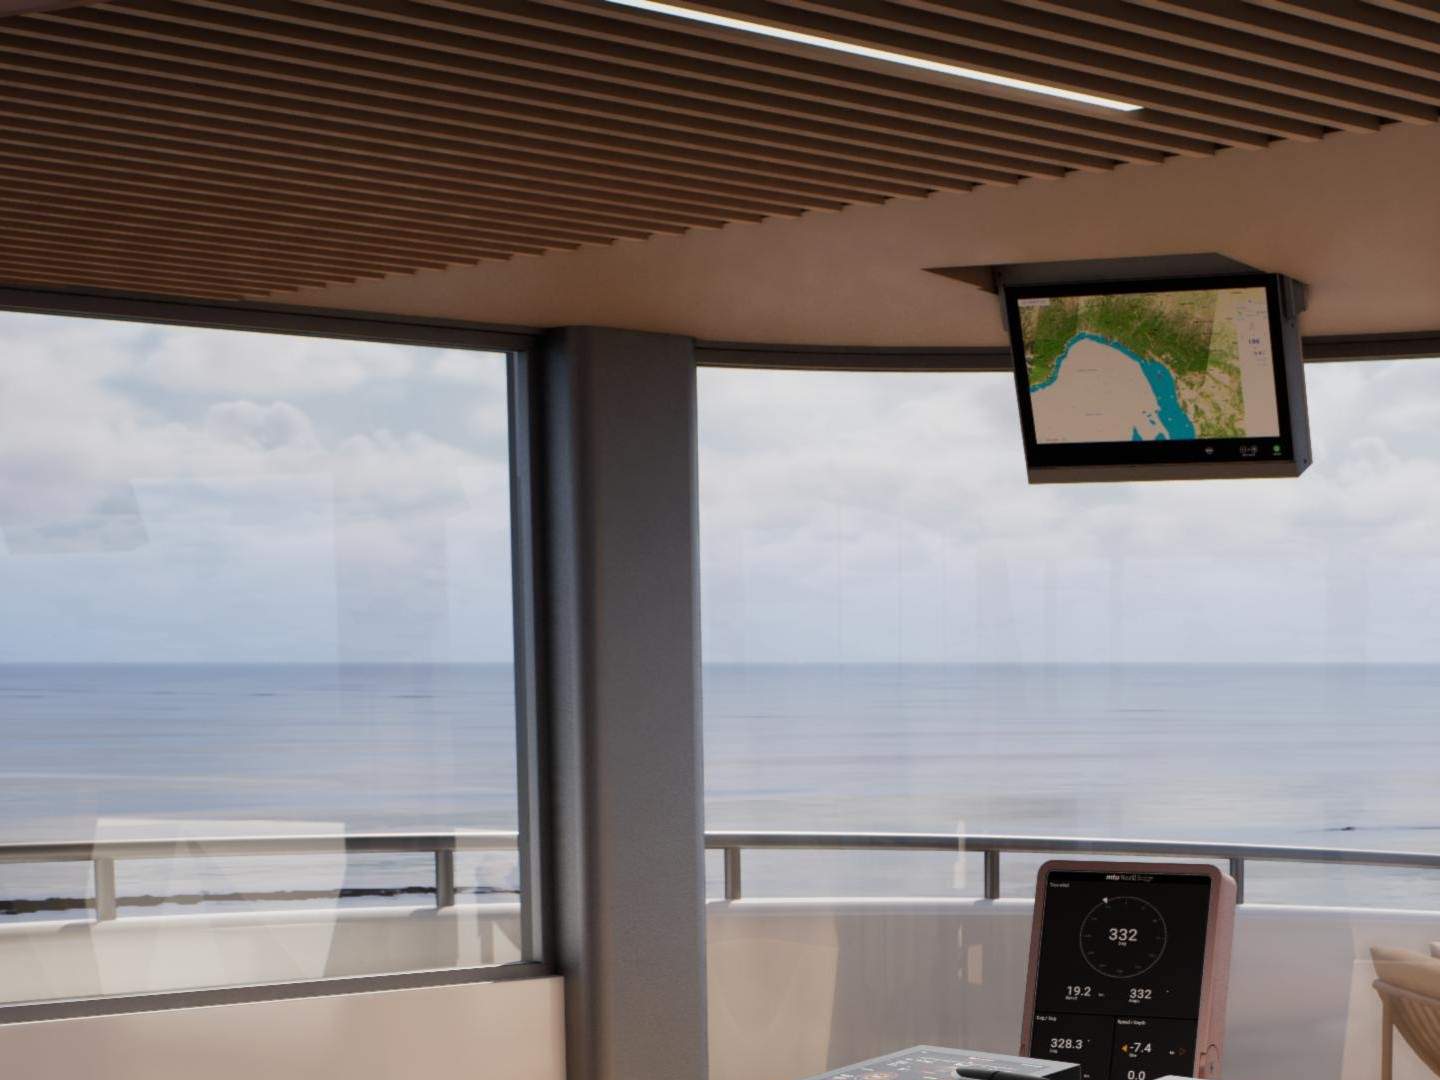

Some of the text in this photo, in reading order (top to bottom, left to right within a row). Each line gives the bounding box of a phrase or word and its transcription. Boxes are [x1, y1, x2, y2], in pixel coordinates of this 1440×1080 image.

[1109, 928, 1138, 942] 332
[1067, 986, 1092, 997] 19.2
[1129, 988, 1152, 1000] 332
[1050, 1038, 1083, 1050] 328.3
[1129, 1042, 1152, 1053] -7.4
[1127, 1070, 1146, 1080] 0.0
